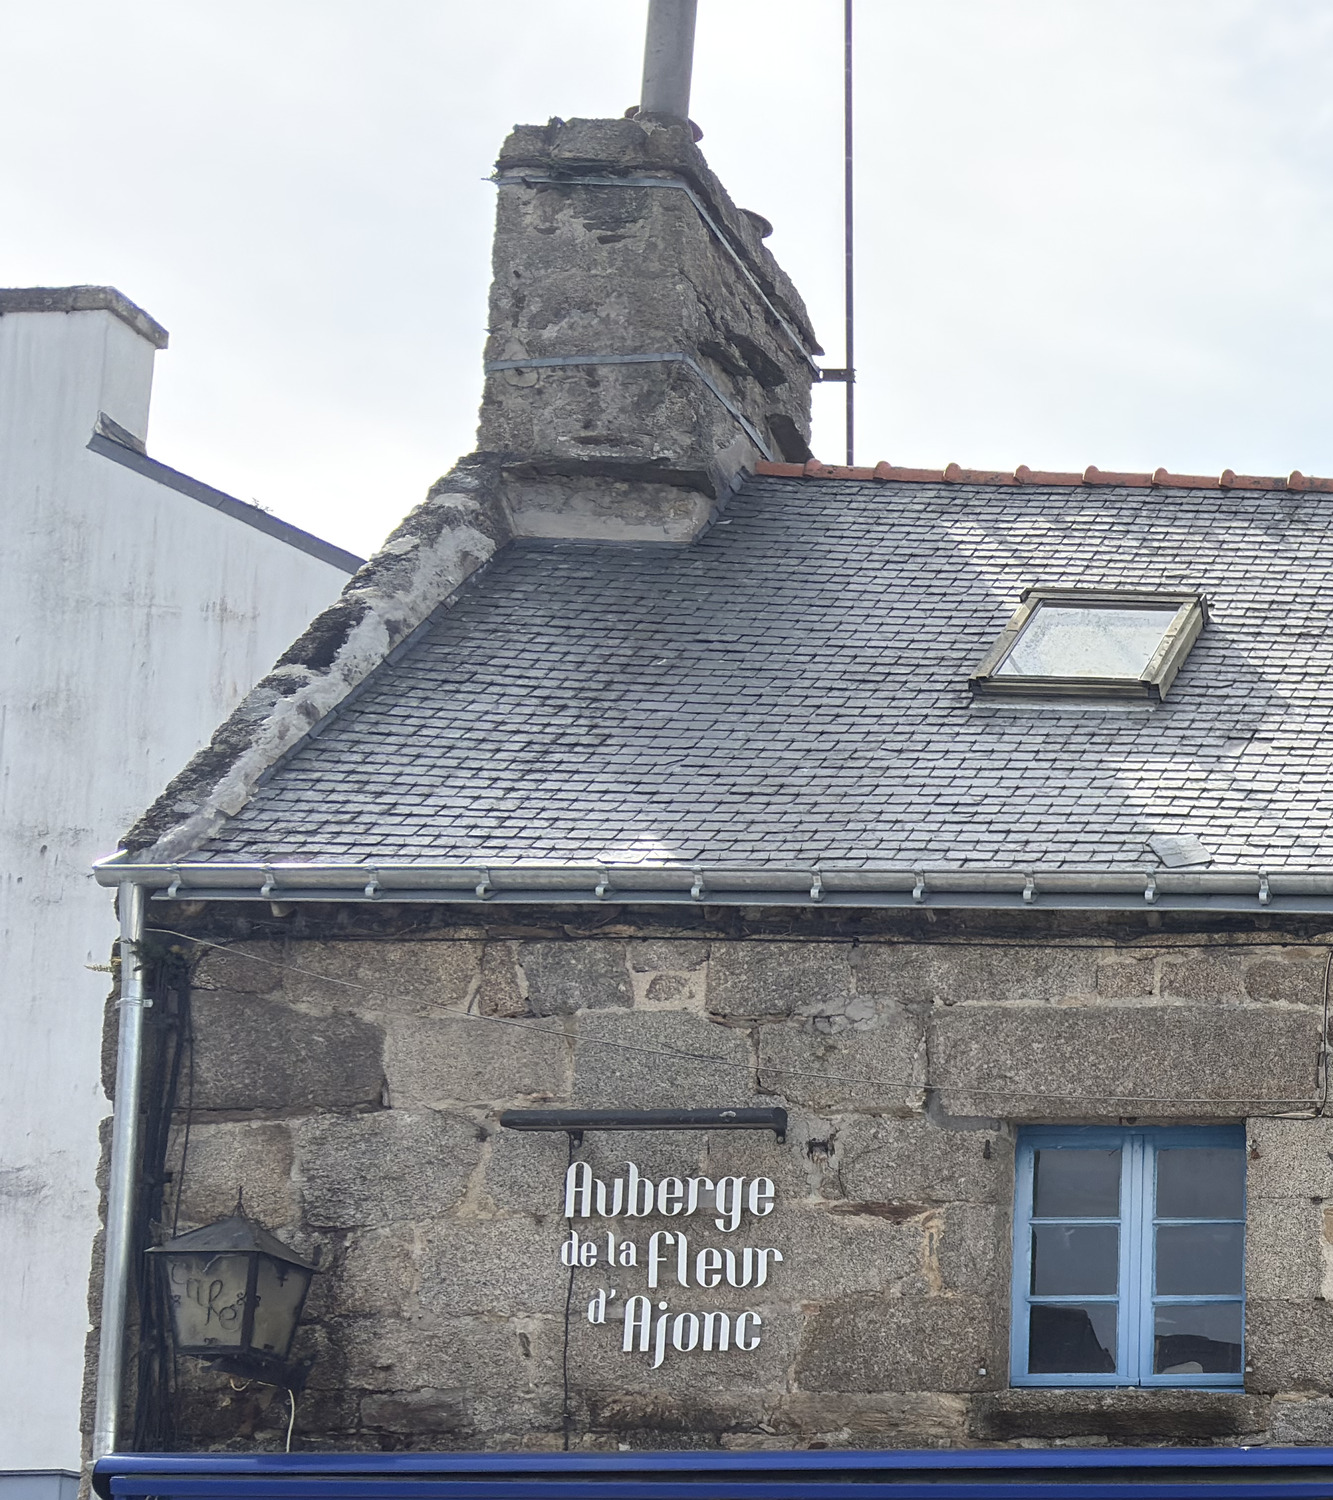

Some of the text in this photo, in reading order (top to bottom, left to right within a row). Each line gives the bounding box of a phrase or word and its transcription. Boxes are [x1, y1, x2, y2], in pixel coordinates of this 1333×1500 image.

[564, 1161, 776, 1233] Auberge
[560, 1230, 597, 1268] de
[606, 1231, 638, 1267] la
